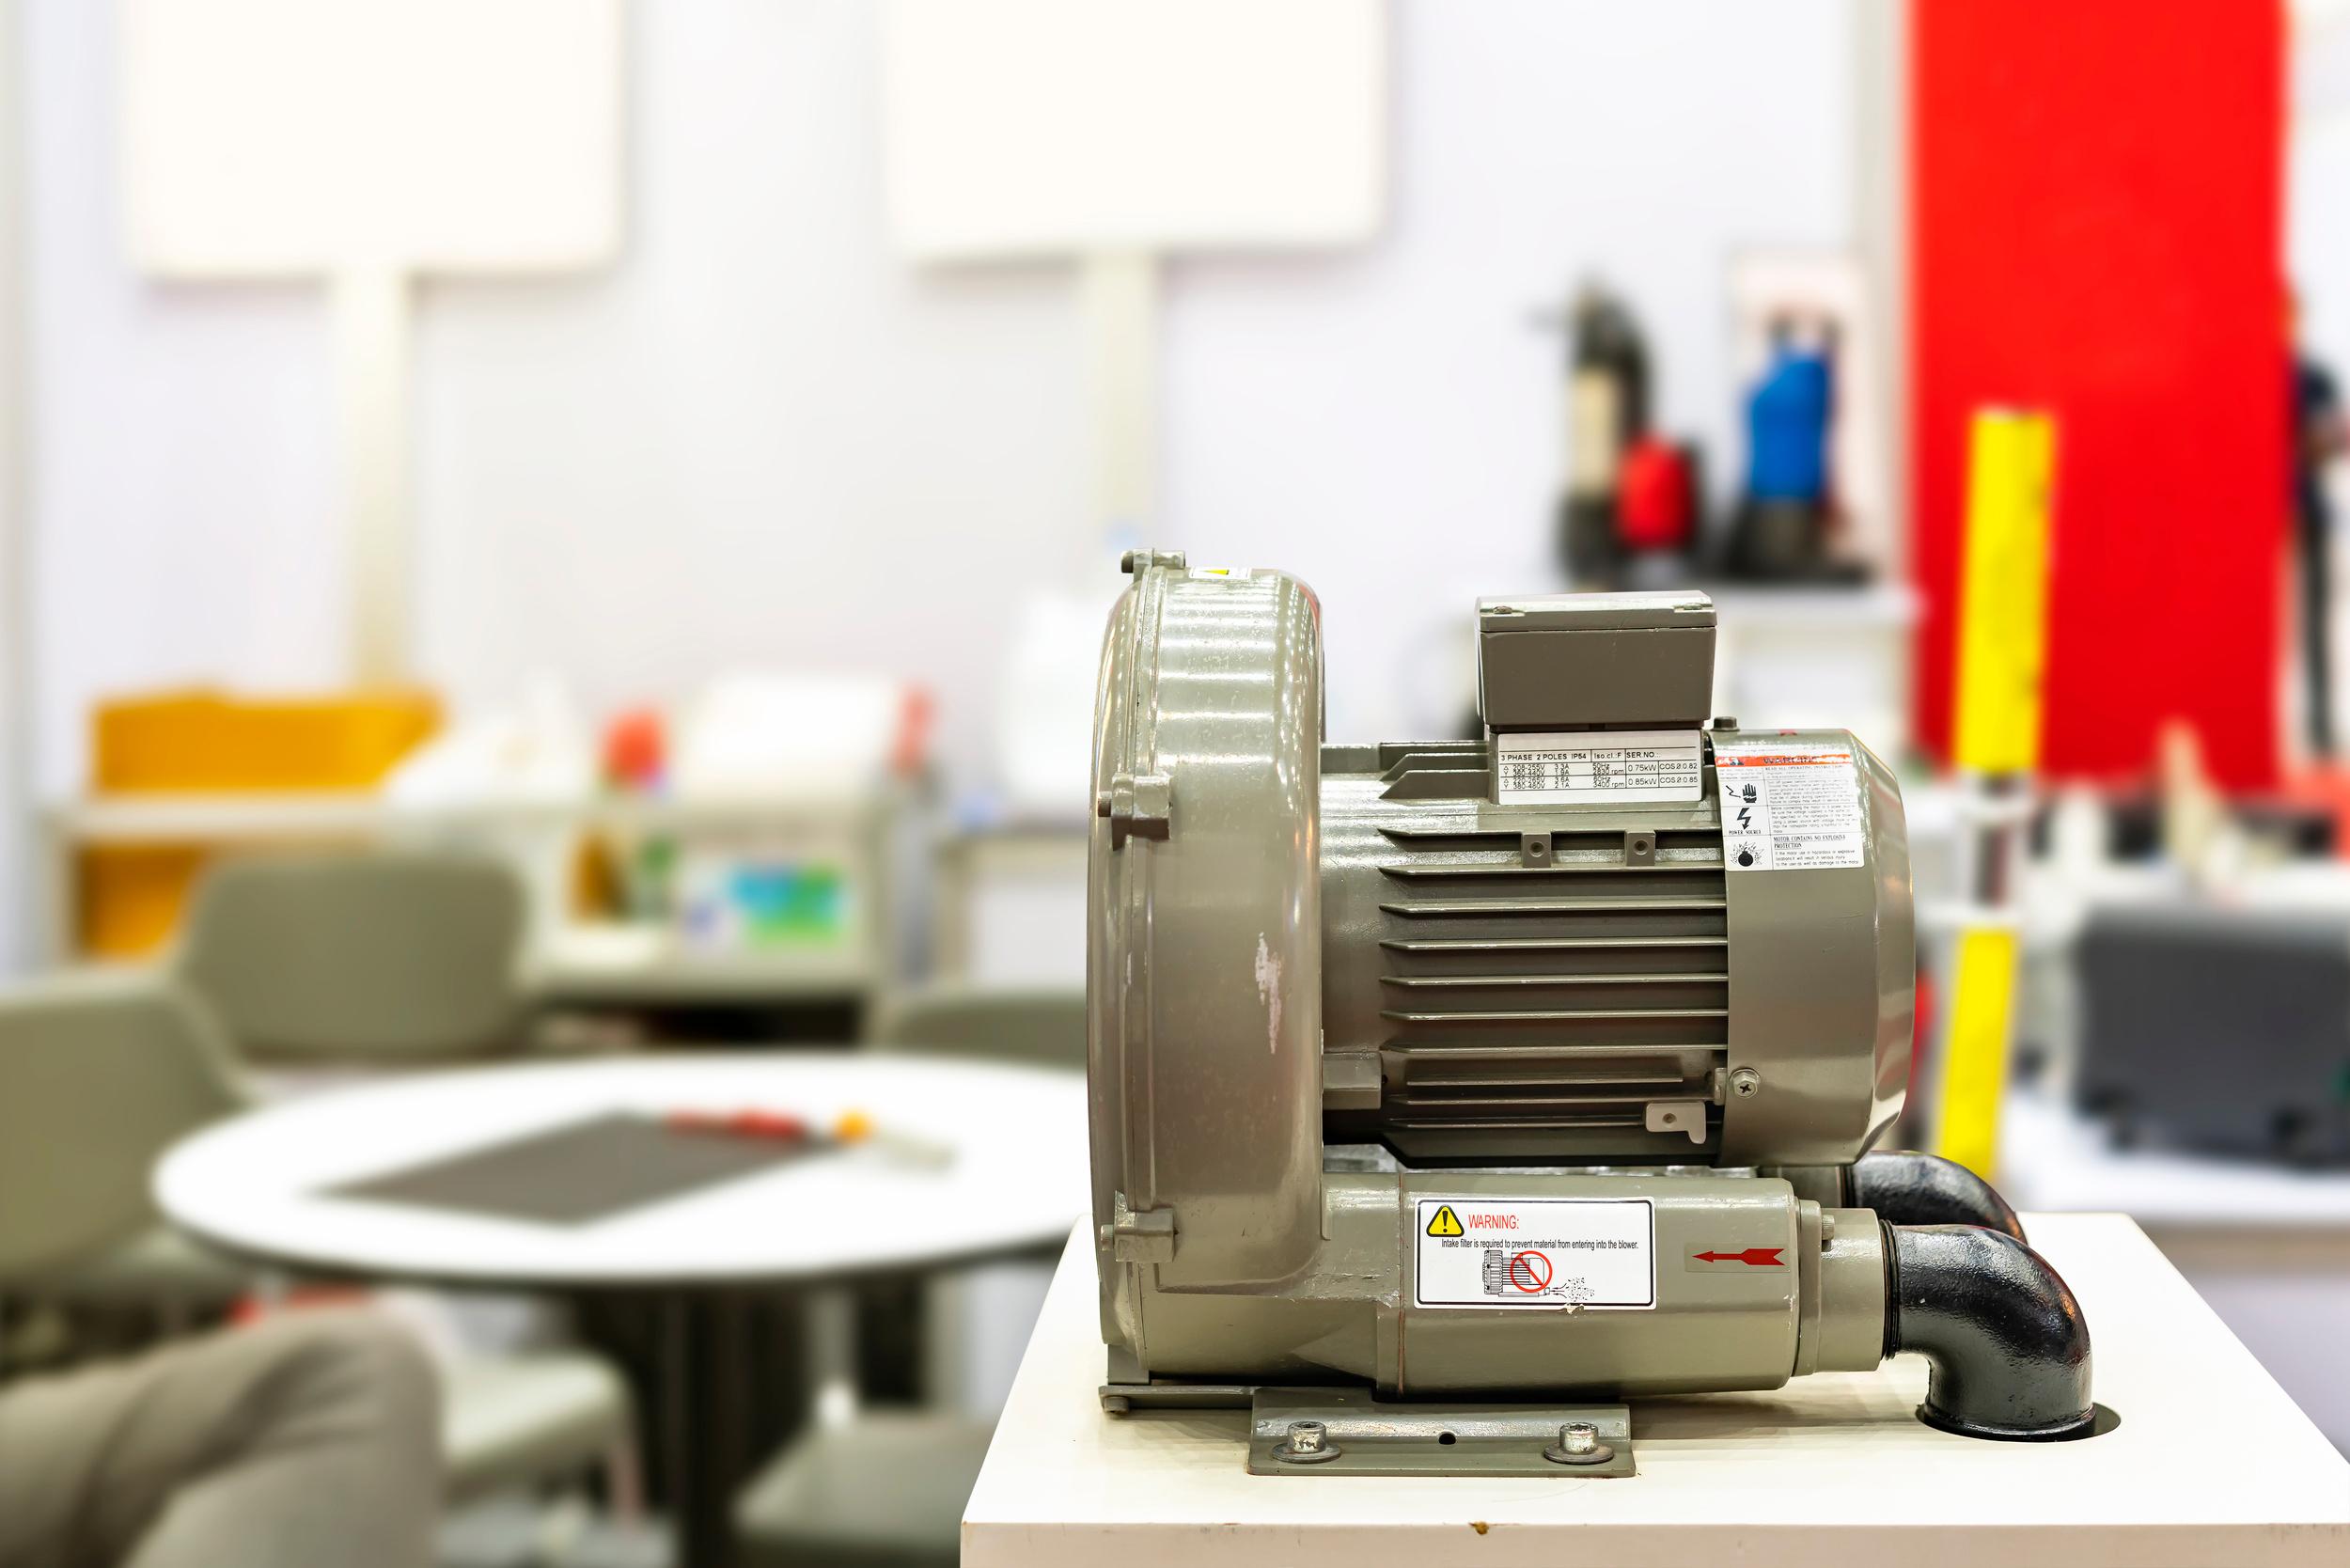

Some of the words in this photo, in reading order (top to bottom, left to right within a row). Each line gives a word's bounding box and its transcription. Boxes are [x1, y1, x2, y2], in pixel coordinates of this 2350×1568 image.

[1468, 1215, 1519, 1230] WARNING:
[1442, 1239, 1459, 1247] Intake
[1461, 1239, 1472, 1247] filter
[1474, 1239, 1479, 1247] is
[1480, 1239, 1503, 1249] required
[1512, 1240, 1531, 1249] prevent
[1534, 1239, 1556, 1248] material
[1558, 1239, 1571, 1248] from
[1572, 1239, 1594, 1251] entering
[1596, 1239, 1606, 1248] into
[1608, 1239, 1617, 1248] the
[1619, 1239, 1638, 1248] blower.
